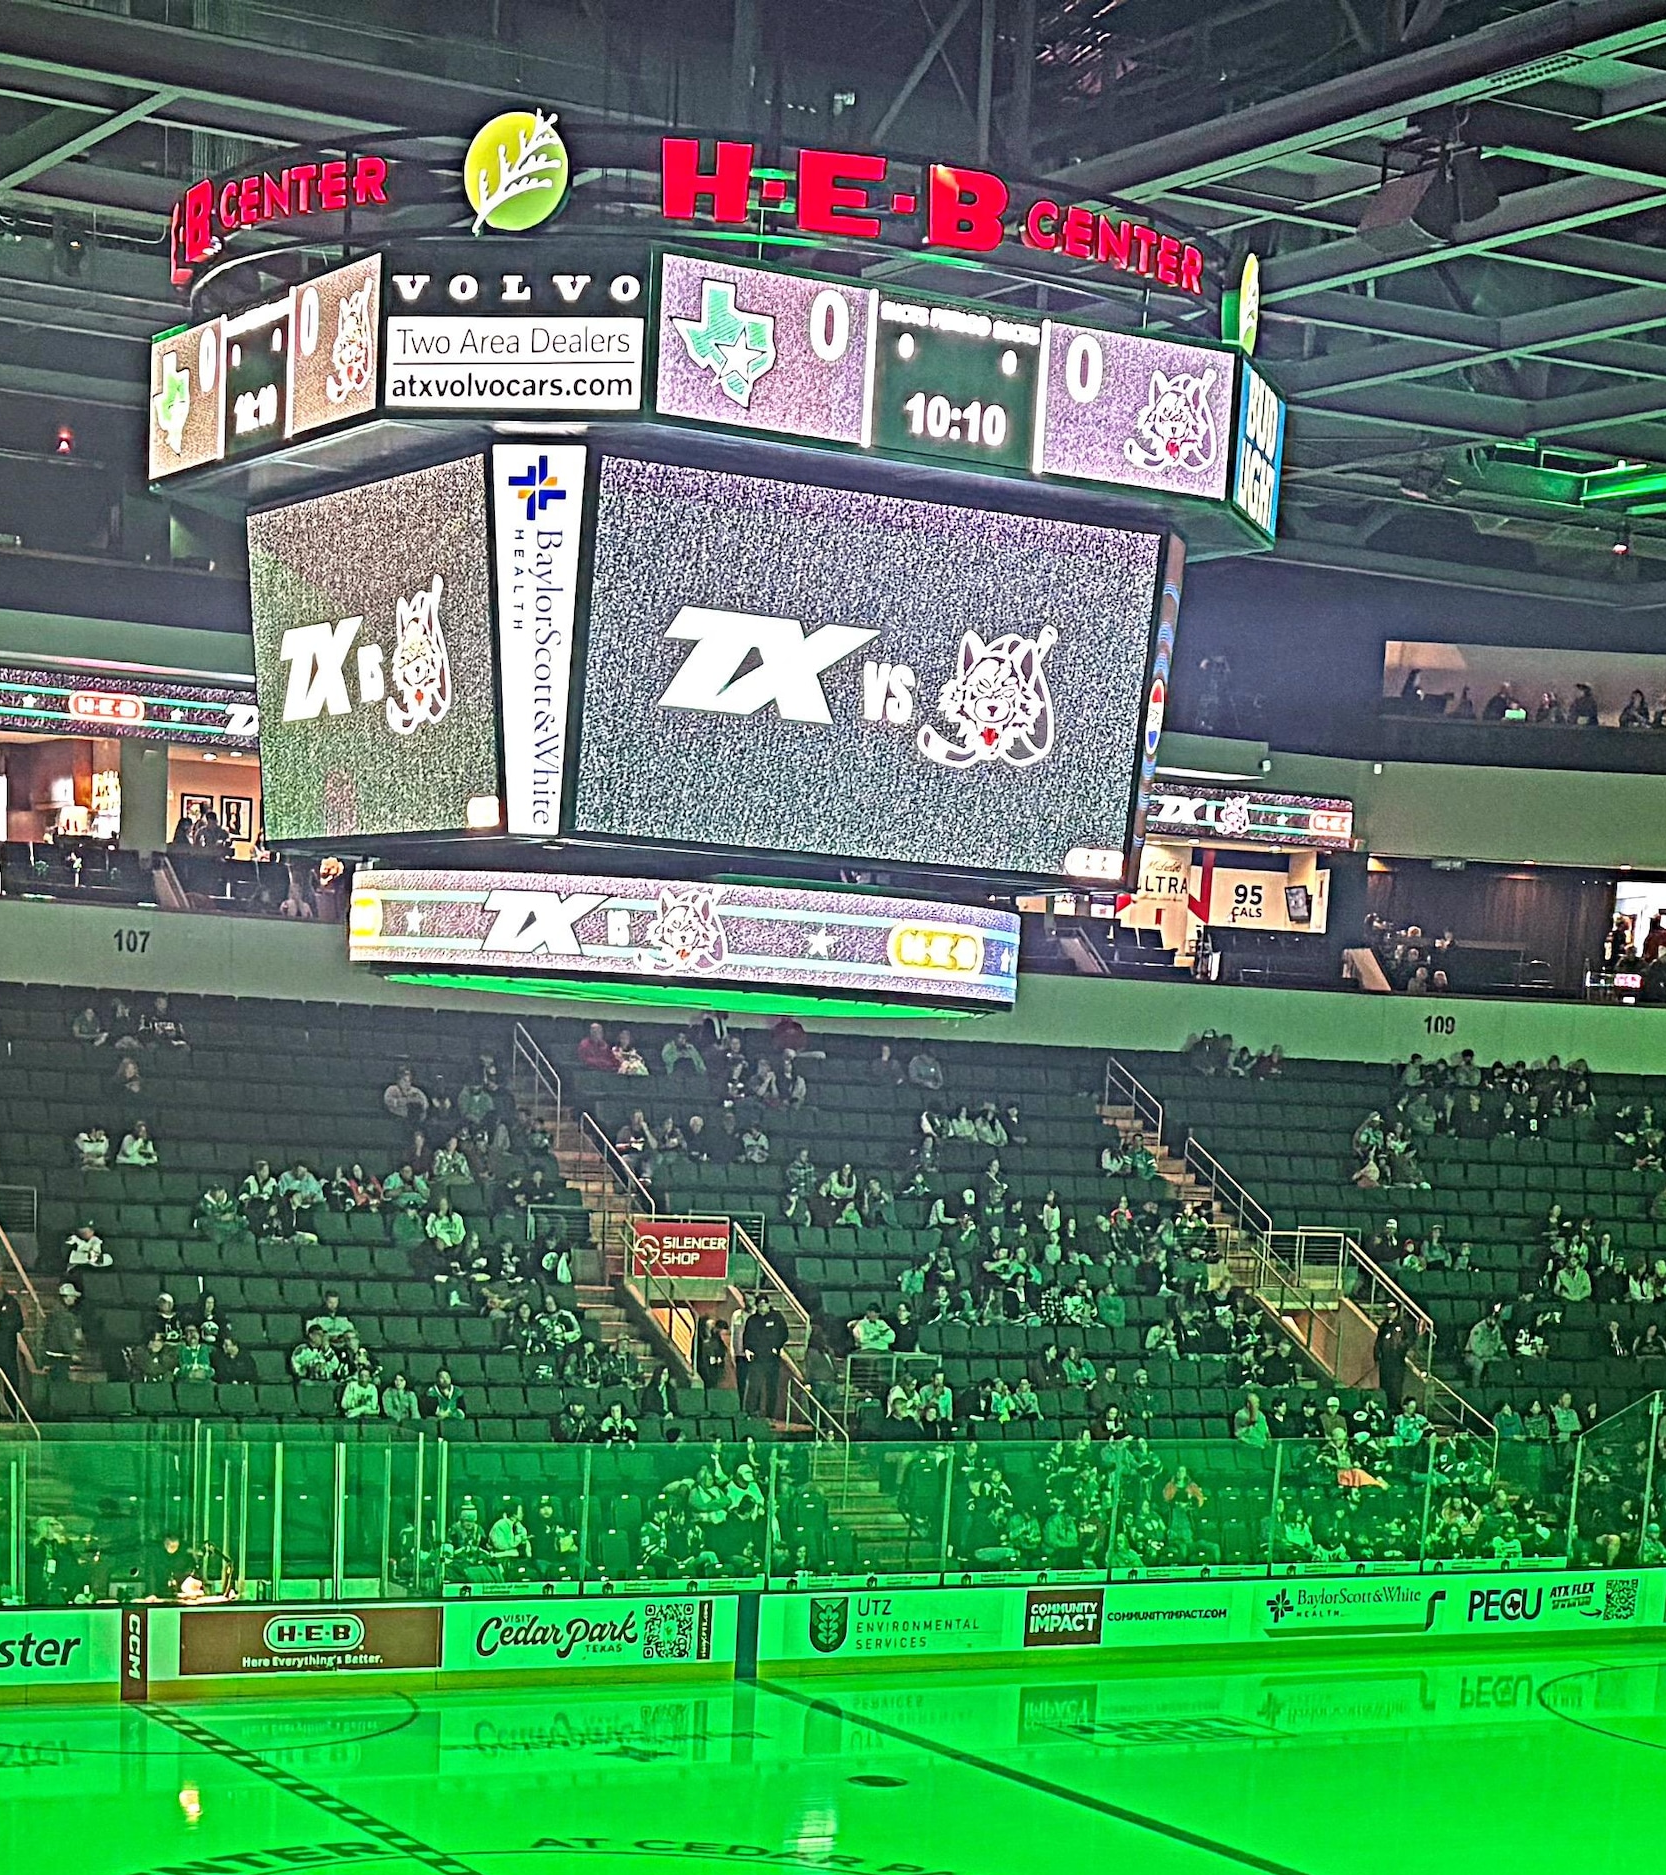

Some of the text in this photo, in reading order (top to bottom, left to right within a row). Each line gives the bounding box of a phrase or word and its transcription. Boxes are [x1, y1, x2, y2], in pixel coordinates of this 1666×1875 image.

[219, 157, 388, 229] CENTER
[1021, 199, 1204, 295] CENTER
[392, 274, 642, 301] VOLVO
[810, 290, 850, 361] 0
[397, 327, 630, 354] Two Area Dealers
[1066, 335, 1103, 403] 0
[392, 375, 633, 398] atxvolvocars.com
[906, 392, 1007, 447] 10:10
[514, 529, 525, 630] HEALTH
[1234, 884, 1263, 905] 95
[1232, 906, 1262, 917] CALS
[114, 929, 152, 954] 107
[1423, 1015, 1456, 1036] 109
[662, 1236, 727, 1251] SILENCER
[662, 1252, 700, 1265] SHOP
[1297, 1585, 1421, 1608] BaylorScott&White
[1549, 1581, 1596, 1599] ATX FLEX
[1030, 1600, 1098, 1617] COMMUNITY
[1107, 1608, 1228, 1623] COMMUNITYIMPACT.COM
[1296, 1610, 1340, 1619] HEALTH
[1468, 1587, 1543, 1622] PECU
[503, 1614, 532, 1623] VISIT
[856, 1617, 980, 1634] ENVIRONMENTAL
[1029, 1613, 1098, 1635] IMPACT
[476, 1610, 638, 1659] Cedar Park
[855, 1635, 927, 1651] SERVICES
[126, 1611, 141, 1681] CCM
[585, 1643, 623, 1653] TEXAS
[242, 1655, 270, 1669] Here
[344, 1652, 384, 1666] Better.
[530, 1837, 610, 1850] AT
[633, 1838, 869, 1870] CEDAR
